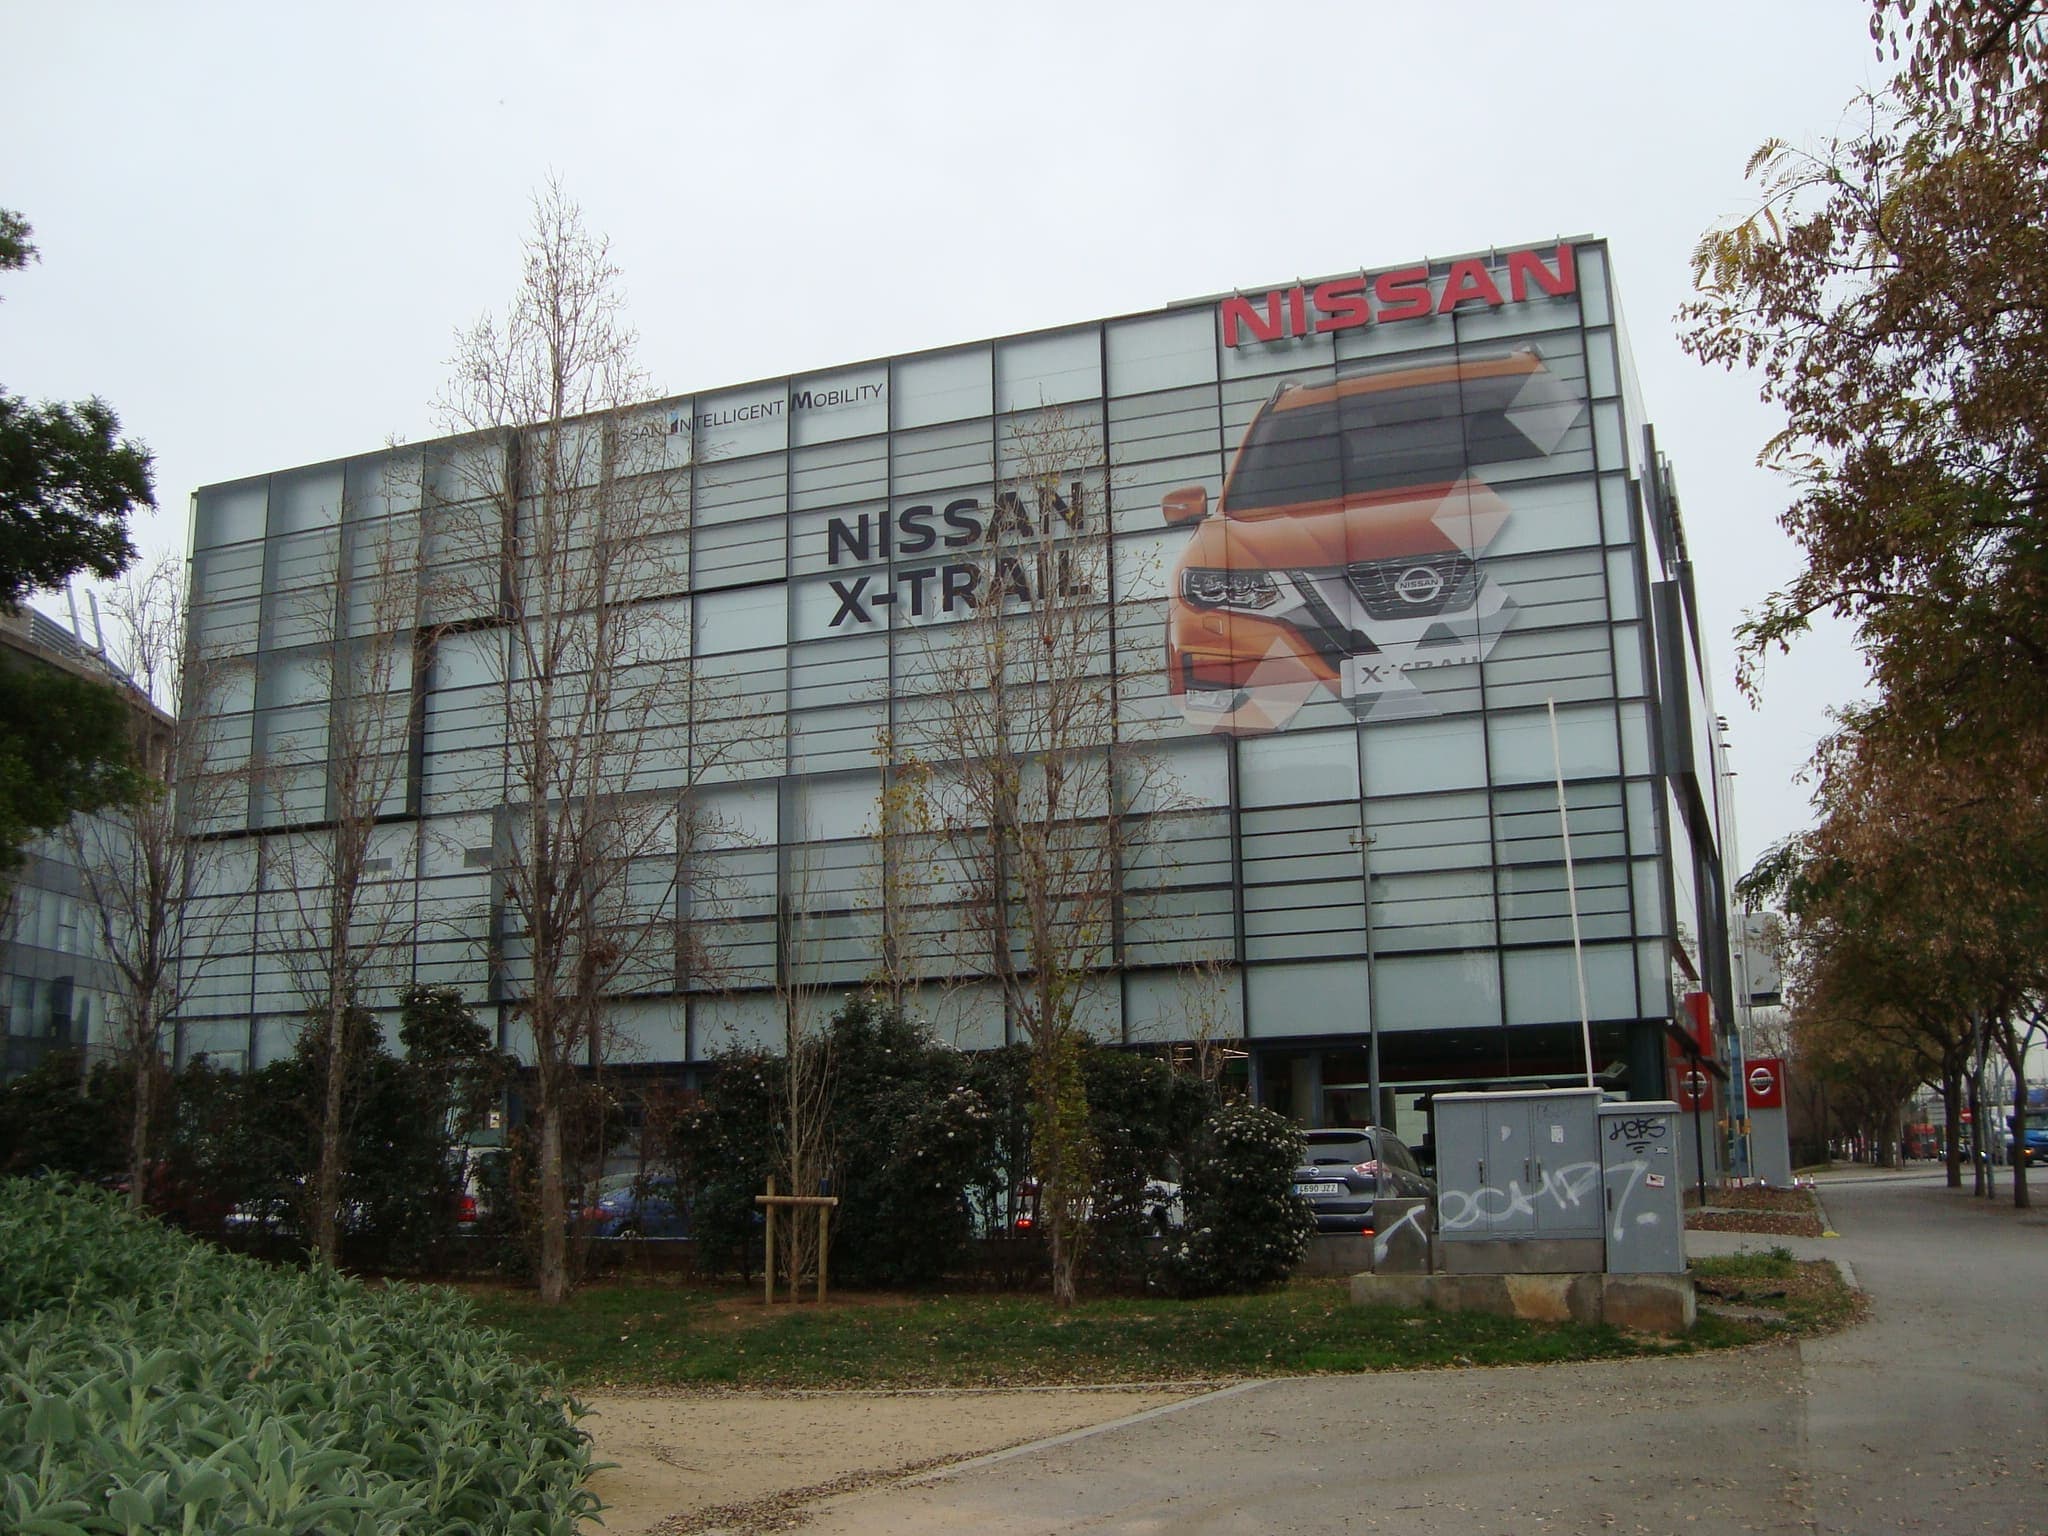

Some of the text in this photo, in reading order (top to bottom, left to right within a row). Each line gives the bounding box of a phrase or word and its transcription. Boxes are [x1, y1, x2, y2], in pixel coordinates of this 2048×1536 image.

[1221, 244, 1576, 348] NISSAN
[791, 383, 883, 411] MOBILITY
[828, 482, 1084, 565] NISSAN
[829, 550, 1091, 627] X-TRAIL
[1400, 578, 1439, 589] NISSAN
